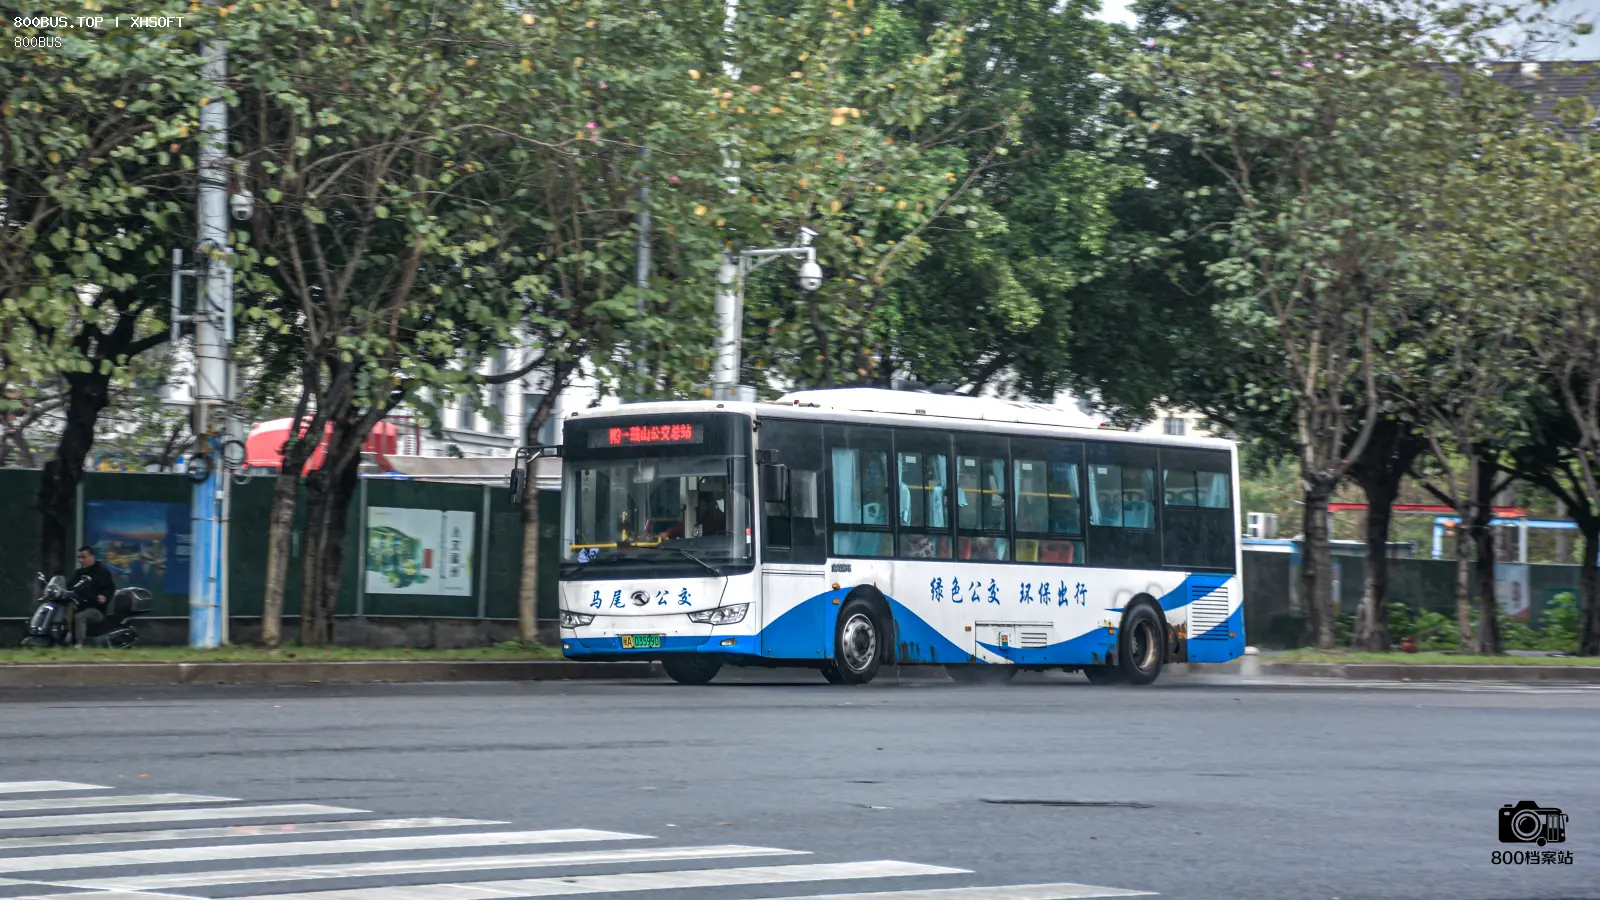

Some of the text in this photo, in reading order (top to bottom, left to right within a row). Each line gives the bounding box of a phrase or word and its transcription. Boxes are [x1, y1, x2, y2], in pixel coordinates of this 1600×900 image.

[589, 587, 692, 610] 马尾 公交
[930, 576, 1088, 607] 绿色公交 环保出行
